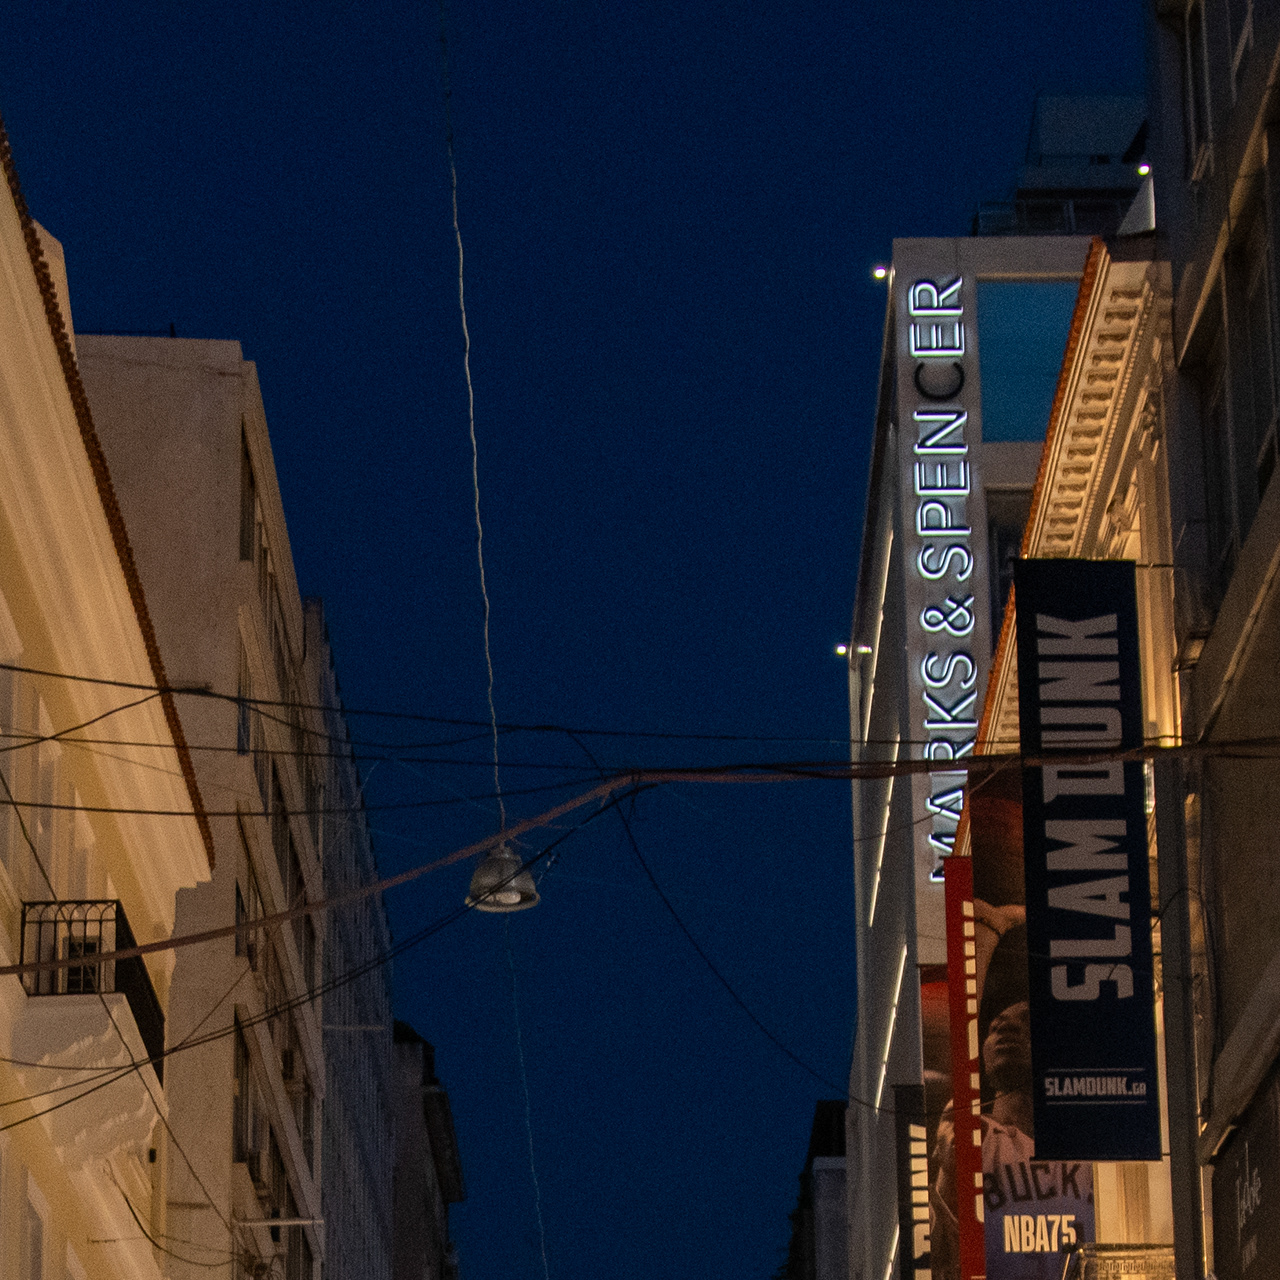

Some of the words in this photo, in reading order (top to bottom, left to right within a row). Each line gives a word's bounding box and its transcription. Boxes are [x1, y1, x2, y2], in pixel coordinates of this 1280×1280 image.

[909, 276, 974, 582] SPENCER
[921, 594, 975, 636] &
[1035, 612, 1126, 802] DUNK
[1045, 818, 1135, 1002] SLAM
[1044, 1076, 1147, 1096] SLAMDUNK.GR
[983, 1161, 1093, 1213] BUCK
[1004, 1213, 1077, 1254] NBA75
